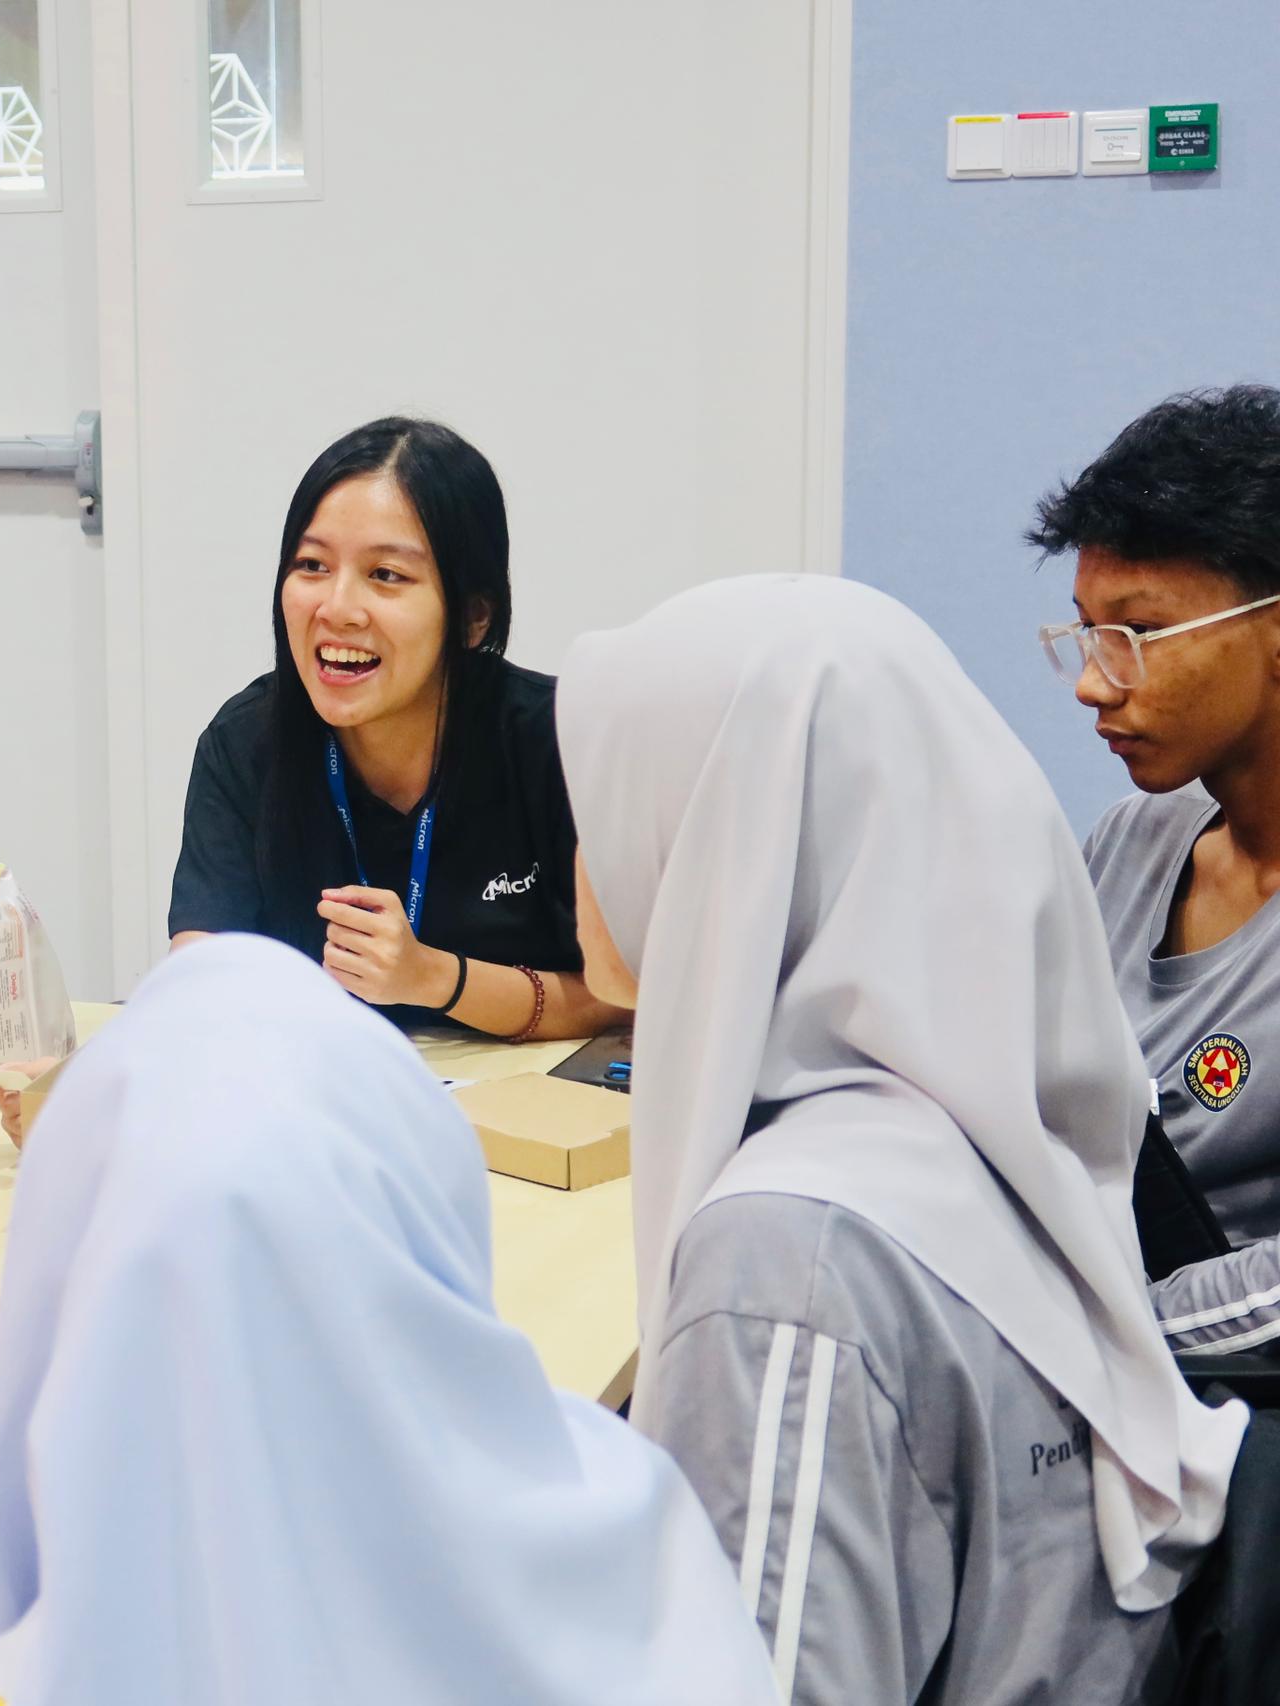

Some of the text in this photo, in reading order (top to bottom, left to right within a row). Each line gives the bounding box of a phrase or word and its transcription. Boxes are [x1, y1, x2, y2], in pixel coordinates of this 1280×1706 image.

[329, 739, 338, 775] icron
[417, 808, 432, 850] Micron
[409, 878, 422, 923] Micron
[1187, 1037, 1249, 1076] SMK PERMAI INDAH
[1187, 1074, 1243, 1108] SENTIASA UNGGUL
